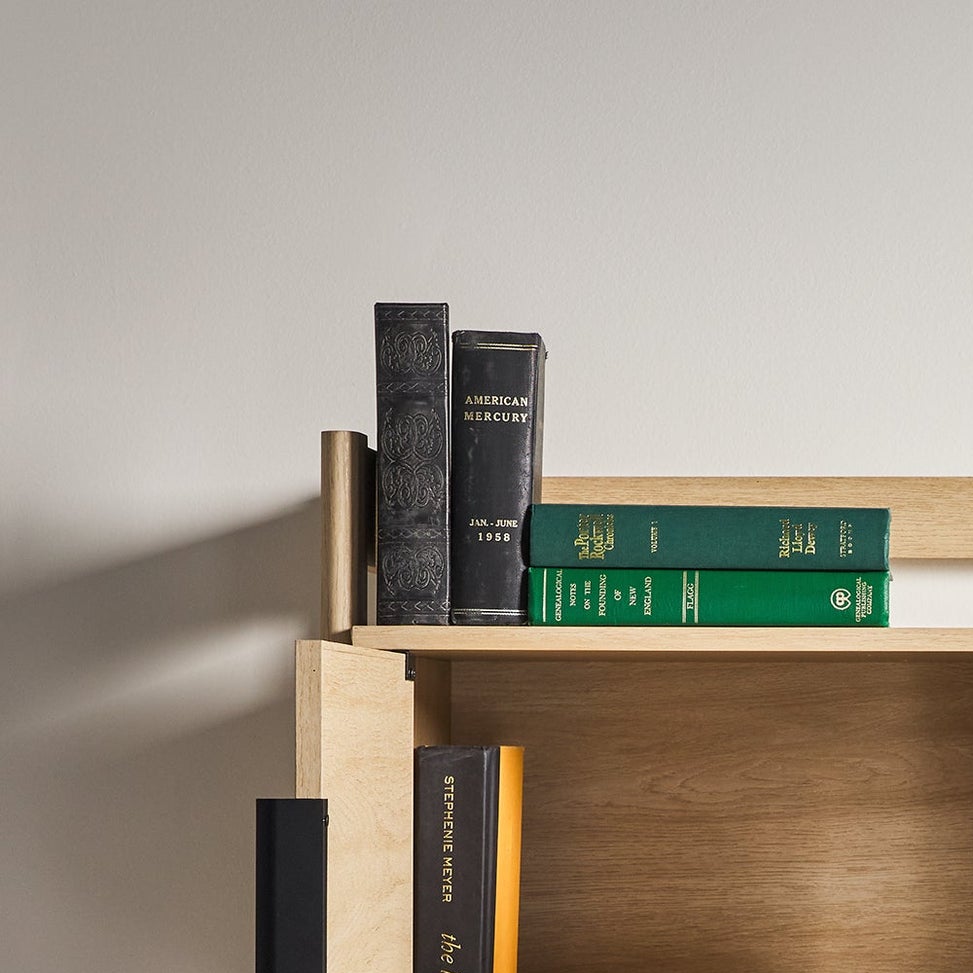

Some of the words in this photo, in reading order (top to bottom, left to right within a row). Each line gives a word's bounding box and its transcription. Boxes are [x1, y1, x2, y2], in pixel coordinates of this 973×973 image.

[465, 395, 528, 407] AMERICAN
[464, 411, 528, 423] MERCURY
[469, 518, 489, 527] JAN.
[495, 519, 519, 528] JUNE
[478, 532, 511, 542] 1958
[555, 569, 563, 621] GENEALOGICAL
[569, 583, 577, 607] NOTES
[584, 580, 592, 595] THE
[598, 574, 607, 617] FOUNDING
[613, 589, 622, 601] OF
[628, 586, 637, 606] NEW
[643, 576, 652, 616] ENGLAND
[686, 583, 694, 610] FLAGG
[583, 598, 591, 610] ON
[443, 775, 455, 853] STEPHENIE
[442, 857, 453, 903] MEYER
[440, 933, 462, 964] the
